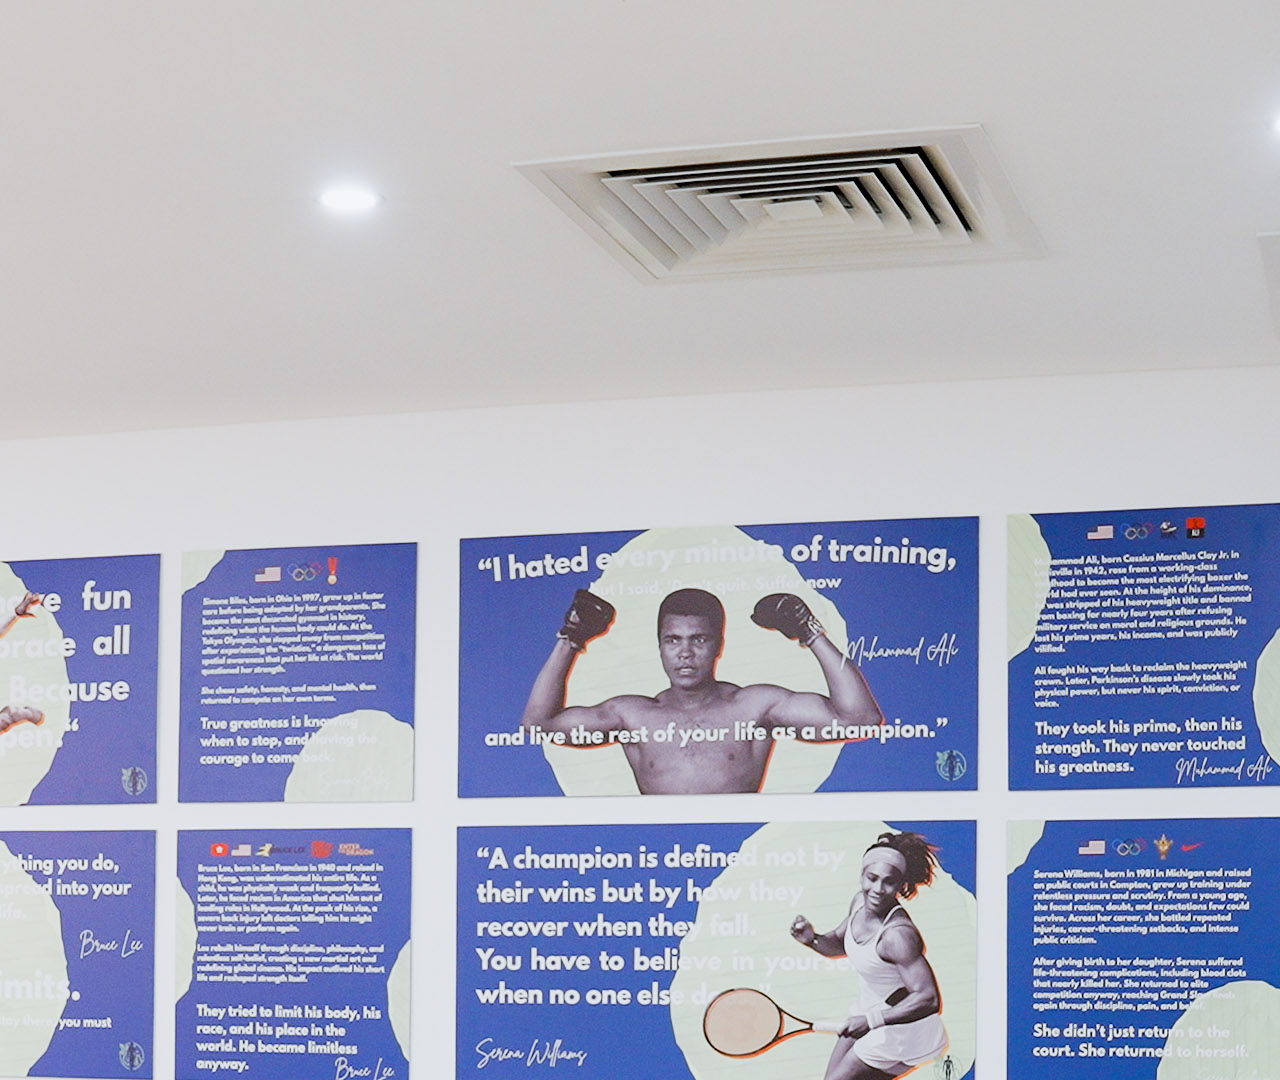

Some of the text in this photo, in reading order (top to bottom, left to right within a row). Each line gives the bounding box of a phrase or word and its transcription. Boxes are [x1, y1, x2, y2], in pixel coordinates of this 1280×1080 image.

[478, 535, 956, 582] “I hated every minute of training,
[806, 576, 841, 590] now
[82, 580, 131, 611] fun
[93, 626, 130, 656] all
[842, 633, 960, 669] Muhammad Ali
[10, 677, 130, 702] Because
[200, 715, 358, 732] True greatness is knowing
[485, 717, 949, 747] and live the rest of your life as a champion.”
[1035, 717, 1242, 737] They took his prime, then his
[200, 733, 308, 748] when to stop, and
[1035, 737, 1246, 755] strength. They never touched
[200, 753, 299, 767] courage to come
[1035, 760, 1134, 776] his greatness.
[1176, 755, 1272, 784] Muhammad Ali
[56, 857, 88, 874] you
[92, 854, 119, 874] do,
[477, 843, 756, 873] “A champion is defined
[1034, 870, 1064, 878] Serena
[1166, 869, 1204, 879] Michigan
[1206, 869, 1222, 877] and
[1225, 869, 1251, 877] raised
[56, 880, 88, 896] into
[92, 882, 131, 899] your
[476, 880, 742, 907] their wins but by how
[476, 914, 698, 941] recover when they
[122, 930, 143, 957] Lee
[476, 948, 720, 970] You have to believe
[476, 982, 683, 1005] when no one else
[197, 1004, 381, 1021] They tried to limit his body, his
[59, 1018, 81, 1030] you
[83, 1017, 112, 1028] must
[197, 1023, 345, 1038] race, and his place in the
[1033, 1023, 1184, 1041] She didn't just return
[197, 1041, 358, 1054] world. He became limitless
[475, 1038, 588, 1068] Serena Williams
[1032, 1043, 1173, 1057] court. She returned
[196, 1060, 249, 1073] anyway.
